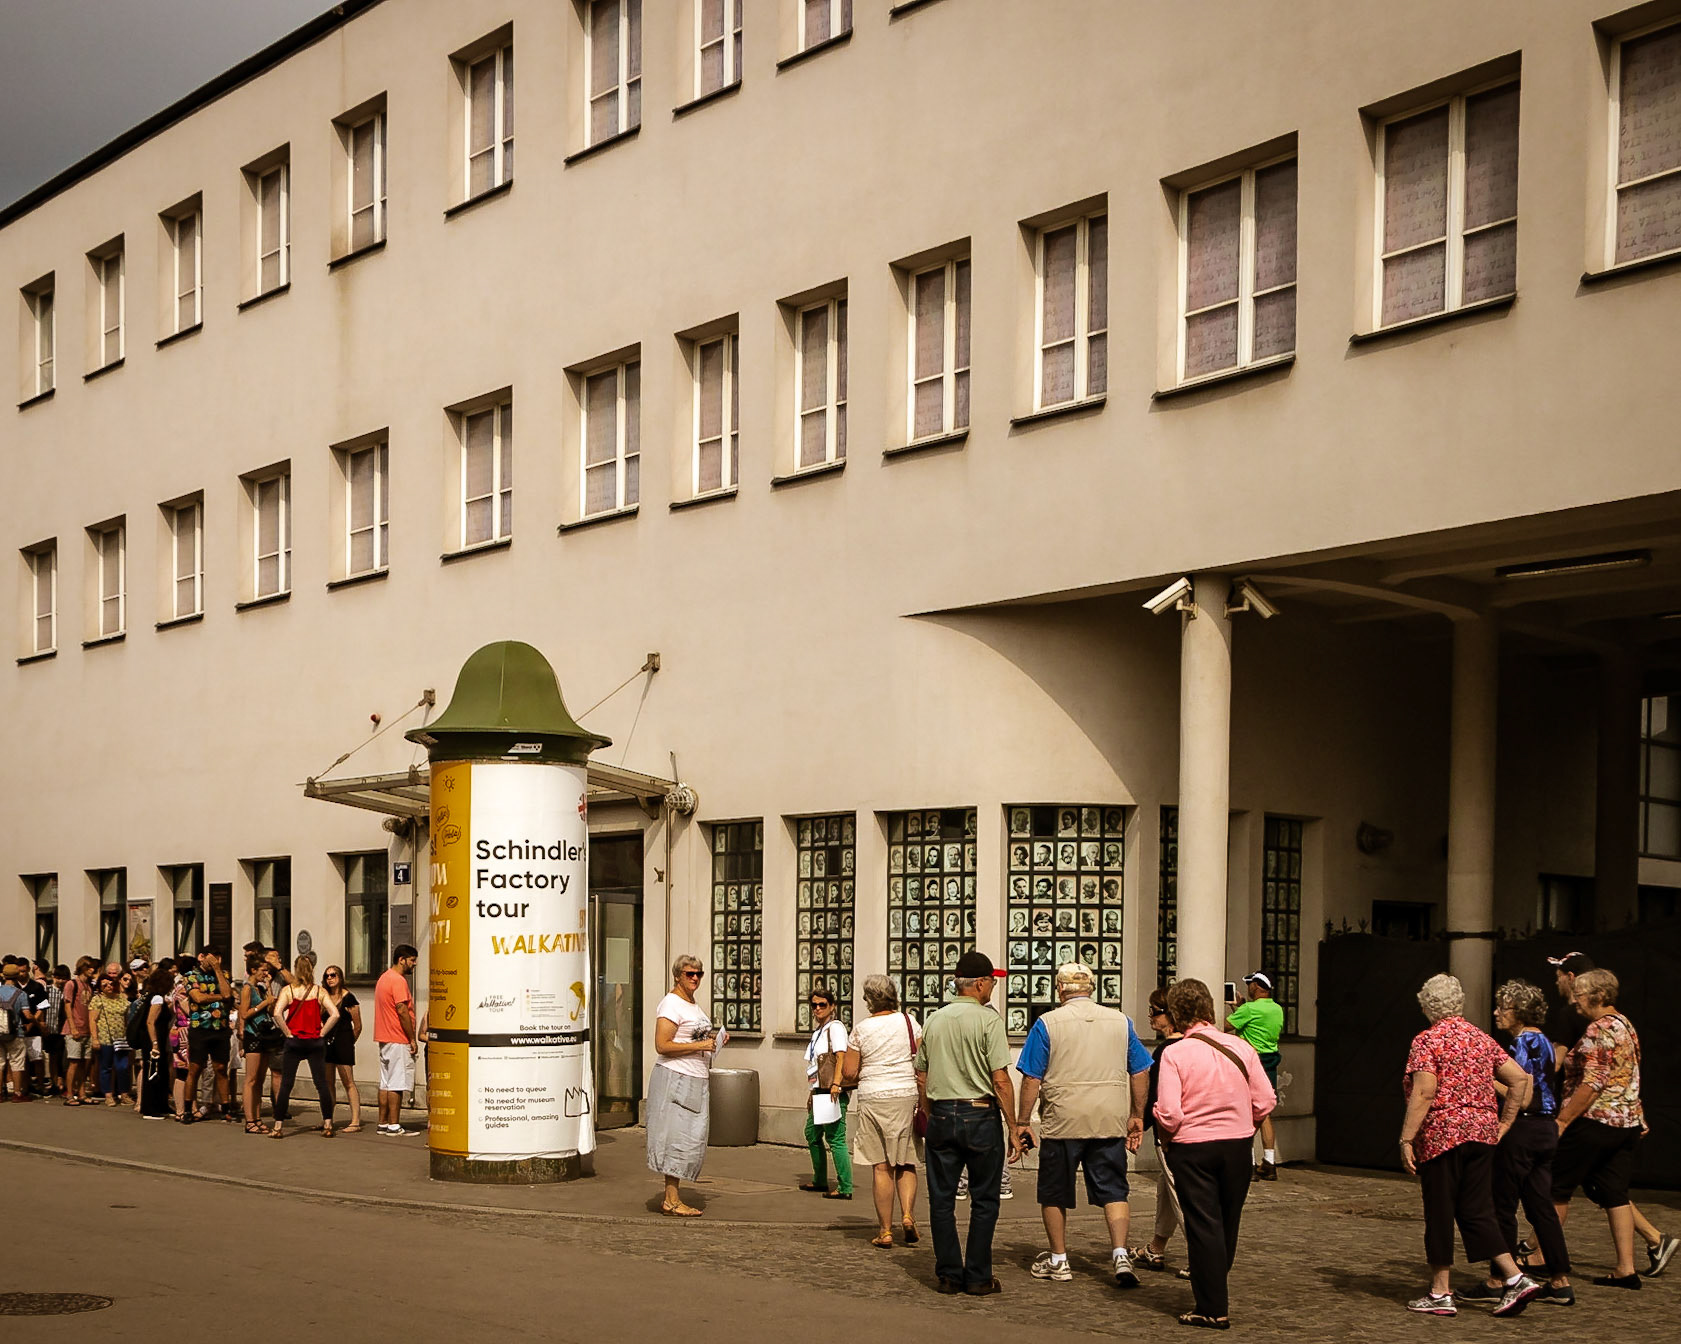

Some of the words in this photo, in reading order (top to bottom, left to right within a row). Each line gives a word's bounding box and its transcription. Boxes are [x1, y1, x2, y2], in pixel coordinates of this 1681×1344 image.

[397, 869, 404, 882] 4
[476, 869, 570, 895] Factory
[476, 900, 530, 918] tour
[525, 1086, 547, 1094] queue
[531, 1113, 559, 1121] amazing
[485, 1122, 509, 1130] guides
